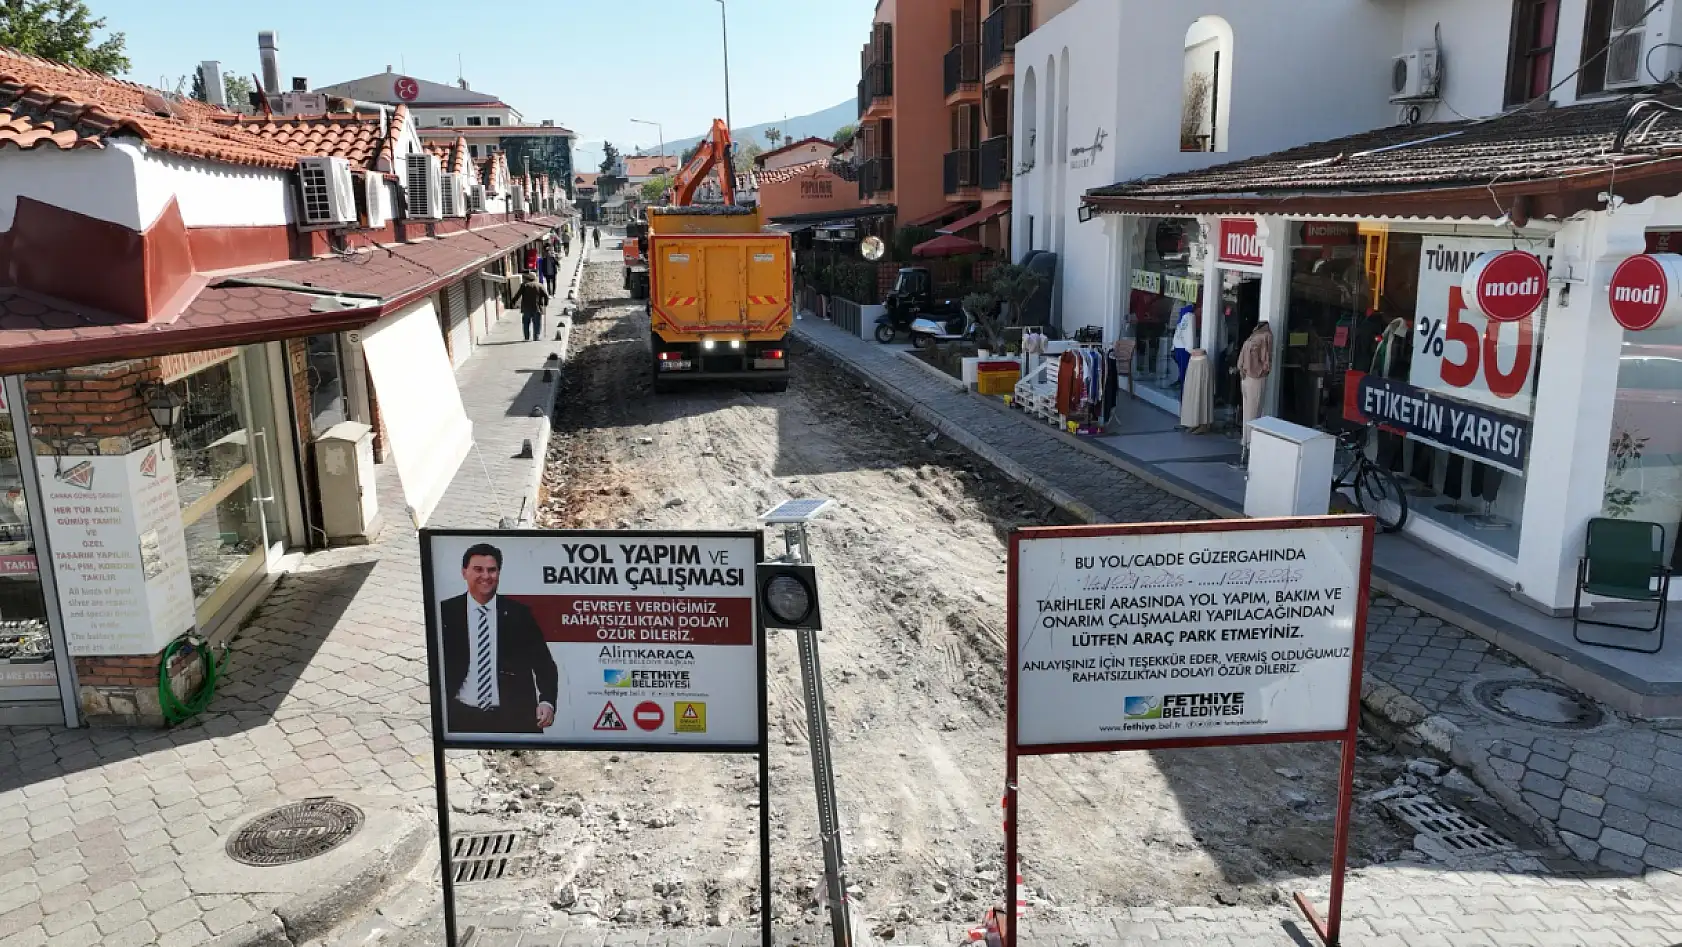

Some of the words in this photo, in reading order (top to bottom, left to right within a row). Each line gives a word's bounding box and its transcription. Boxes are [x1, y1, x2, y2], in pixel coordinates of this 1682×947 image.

[1426, 244, 1458, 272] TÜM
[1485, 277, 1539, 297] modi
[1615, 284, 1660, 305] modi
[1419, 285, 1534, 399] %50
[1364, 383, 1443, 434] ETİKETİN
[1450, 408, 1522, 459] YARISI
[53, 505, 71, 514] HER
[562, 543, 614, 564] YOL
[618, 544, 701, 565] YAPIM
[708, 550, 729, 565] VE
[1075, 556, 1094, 569] BU
[1098, 553, 1185, 569] YOL/CADDE
[1189, 548, 1306, 564] GÜZERGAHINDA
[81, 573, 116, 581] TAKILIR
[543, 566, 618, 585] BAKIM
[625, 566, 744, 591] ÇALIŞMASI
[68, 598, 89, 606] silver
[572, 600, 631, 614] ÇEVREYE
[636, 598, 717, 614] VERDİĞİMİZ
[1037, 599, 1106, 613] TARİHLERİ
[1110, 596, 1184, 610] ARASINDA
[1189, 594, 1219, 607] YOL
[1223, 593, 1270, 607] YAPIM,
[1275, 590, 1320, 604] BAKIM
[1324, 588, 1342, 601] VE
[71, 610, 84, 618] and
[561, 614, 674, 627] RAHATSIZLIKTAN
[678, 616, 729, 628] DOLAYI
[1043, 615, 1104, 629] ONARIM
[1108, 611, 1201, 629] ÇALIŞMALARI
[1207, 604, 1335, 622] YAPILACAĞINDAN
[597, 627, 637, 640] ÖZÜR
[640, 627, 694, 641] DİLERİZ.
[1072, 632, 1128, 648] LÜTFEN
[1133, 633, 1174, 647] ARAÇ
[1178, 630, 1216, 643] PARK
[1221, 626, 1304, 641] ETMEYİNİZ.
[1022, 658, 1095, 673] ANLAYIŞINIZ
[1099, 656, 1125, 670] İÇİN
[1129, 652, 1186, 669] TEŞEKKÜR
[1190, 653, 1222, 666] EDER,
[1226, 651, 1268, 664] VERMİŞ
[1271, 647, 1350, 661] OLDUĞUMUZ
[1072, 669, 1167, 683] RAHATSIZLIKTAN
[1171, 667, 1214, 679] DOLAYI
[1218, 663, 1252, 676] ÖZÜR
[1099, 721, 1182, 732] www.fethiye.bel.tr
